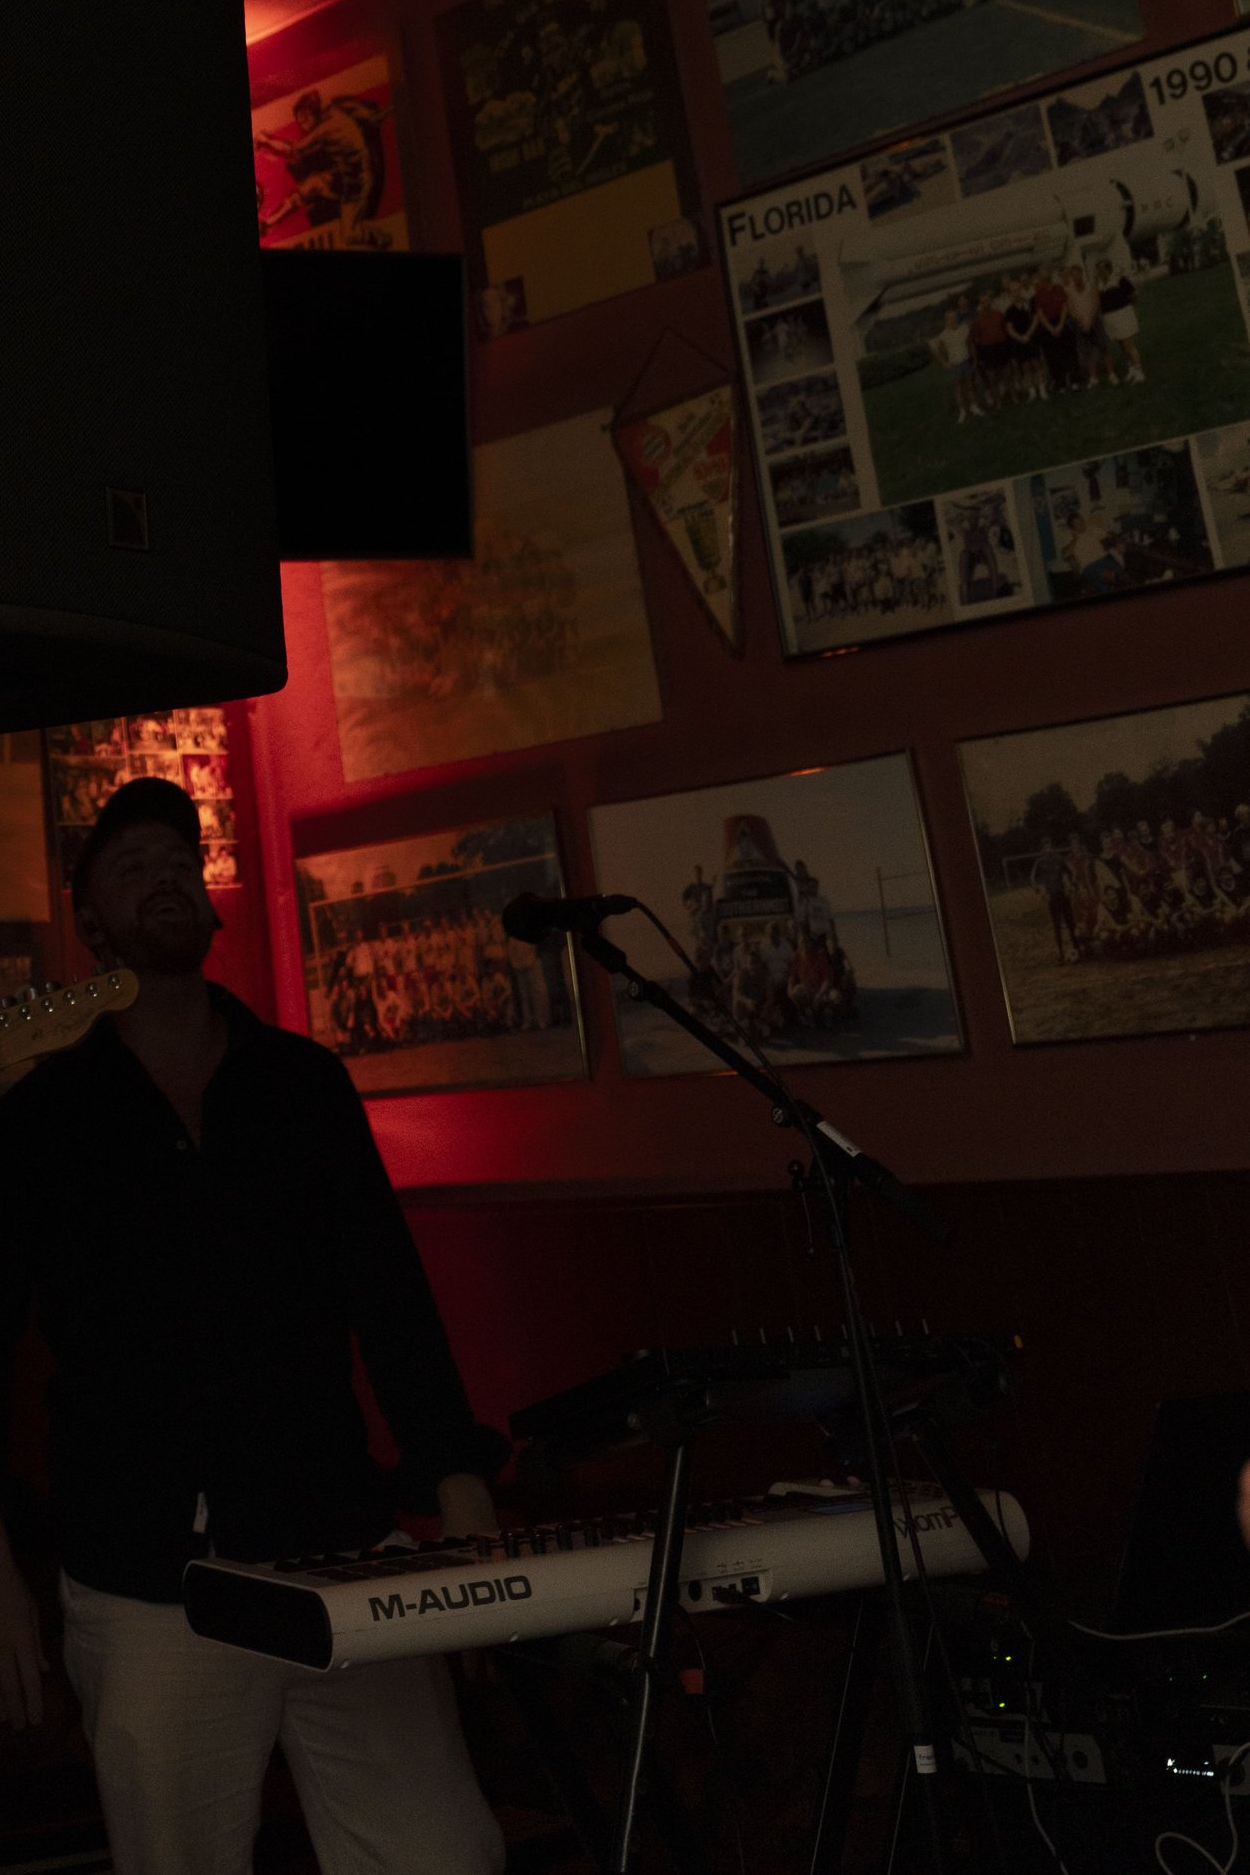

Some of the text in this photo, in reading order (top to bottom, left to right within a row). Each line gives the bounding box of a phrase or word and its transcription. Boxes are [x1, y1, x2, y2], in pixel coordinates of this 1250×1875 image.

[1148, 51, 1238, 105] 1990
[727, 183, 858, 247] FLORIDA
[368, 1575, 533, 1622] M-AUDIO
